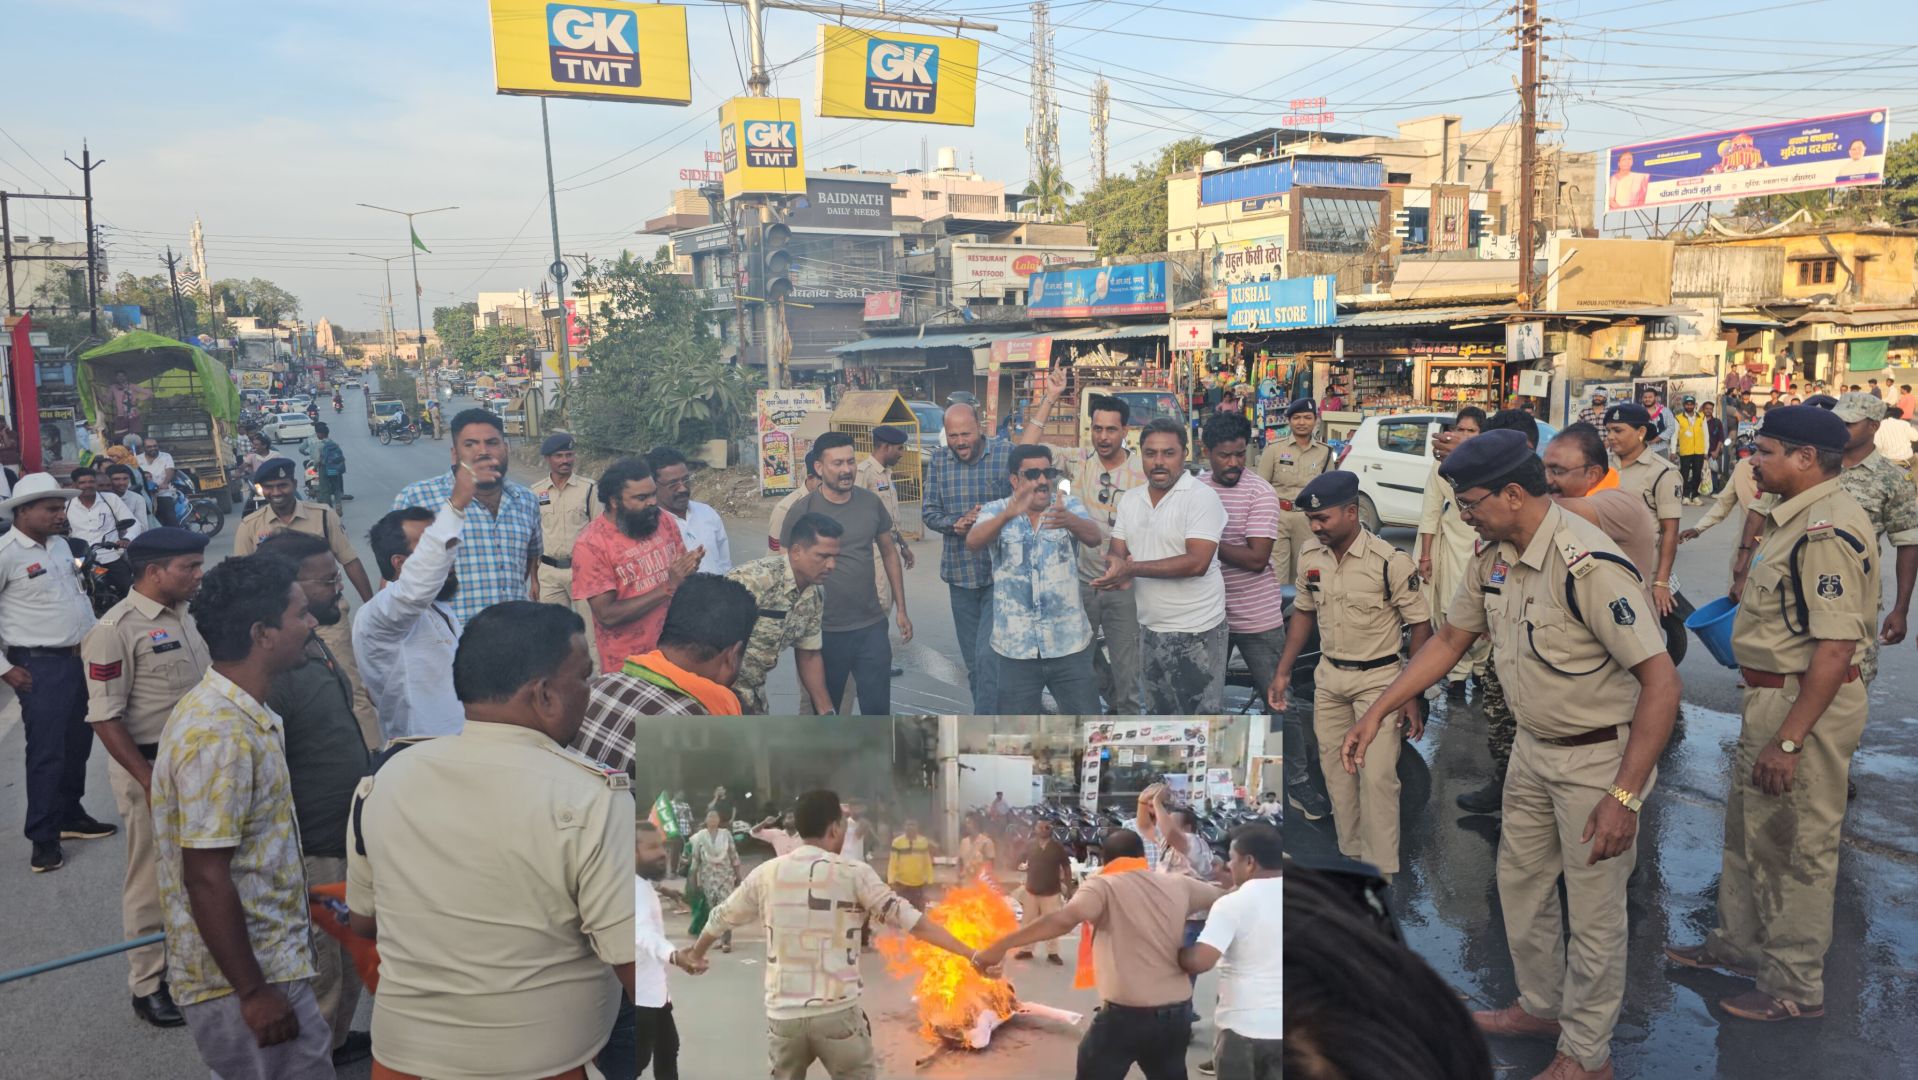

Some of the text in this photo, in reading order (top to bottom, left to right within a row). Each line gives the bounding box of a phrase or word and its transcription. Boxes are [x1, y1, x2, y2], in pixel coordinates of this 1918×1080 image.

[552, 8, 634, 54] GK
[559, 58, 632, 83] TMT
[870, 43, 935, 84] GK
[872, 88, 930, 110] TMT
[722, 125, 737, 154] GK
[747, 122, 793, 148] GK
[750, 152, 793, 166] TMT
[1808, 142, 1837, 155] दरबार
[724, 155, 737, 171] TMT
[818, 192, 884, 206] BAIDNATH
[827, 207, 880, 217] DAILY NEEDS
[967, 254, 1007, 263] RESTAURANT
[1225, 252, 1244, 273] राहुल
[1265, 242, 1282, 263] स्टोर
[1231, 285, 1271, 304] KUSHAL
[1231, 305, 1308, 327] MEDICAL STORE
